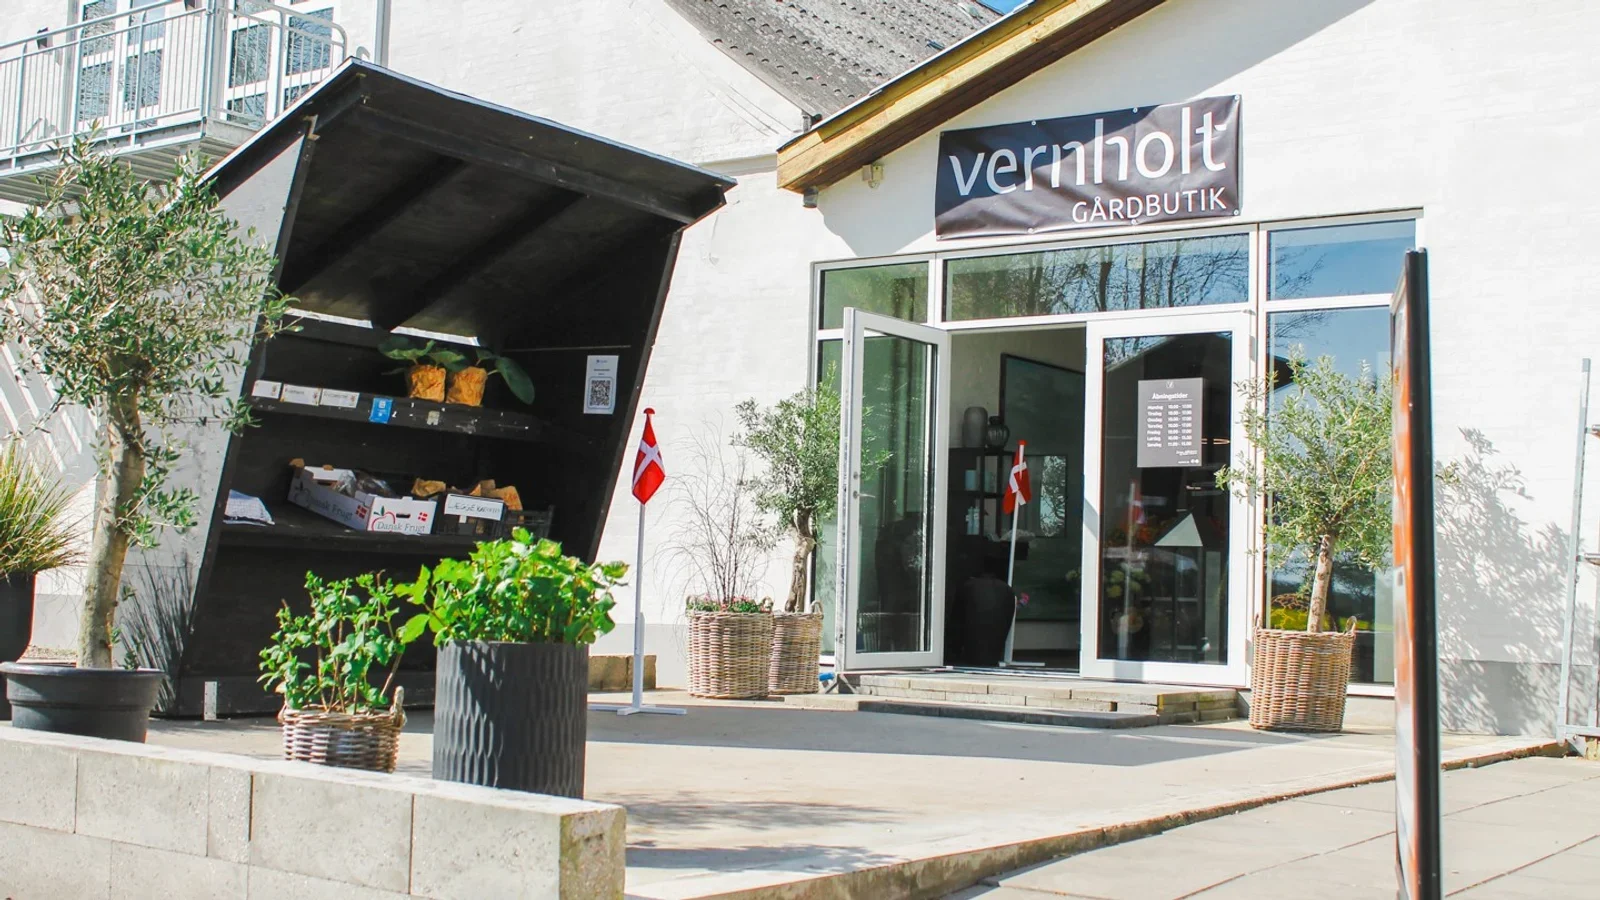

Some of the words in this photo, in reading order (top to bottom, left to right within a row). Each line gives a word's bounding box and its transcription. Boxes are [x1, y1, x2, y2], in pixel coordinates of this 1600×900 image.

[949, 106, 1228, 196] vernholt
[1072, 186, 1228, 223] GÅRDBUTIK
[377, 521, 402, 531] Dansk
[404, 523, 426, 534] Frugt
